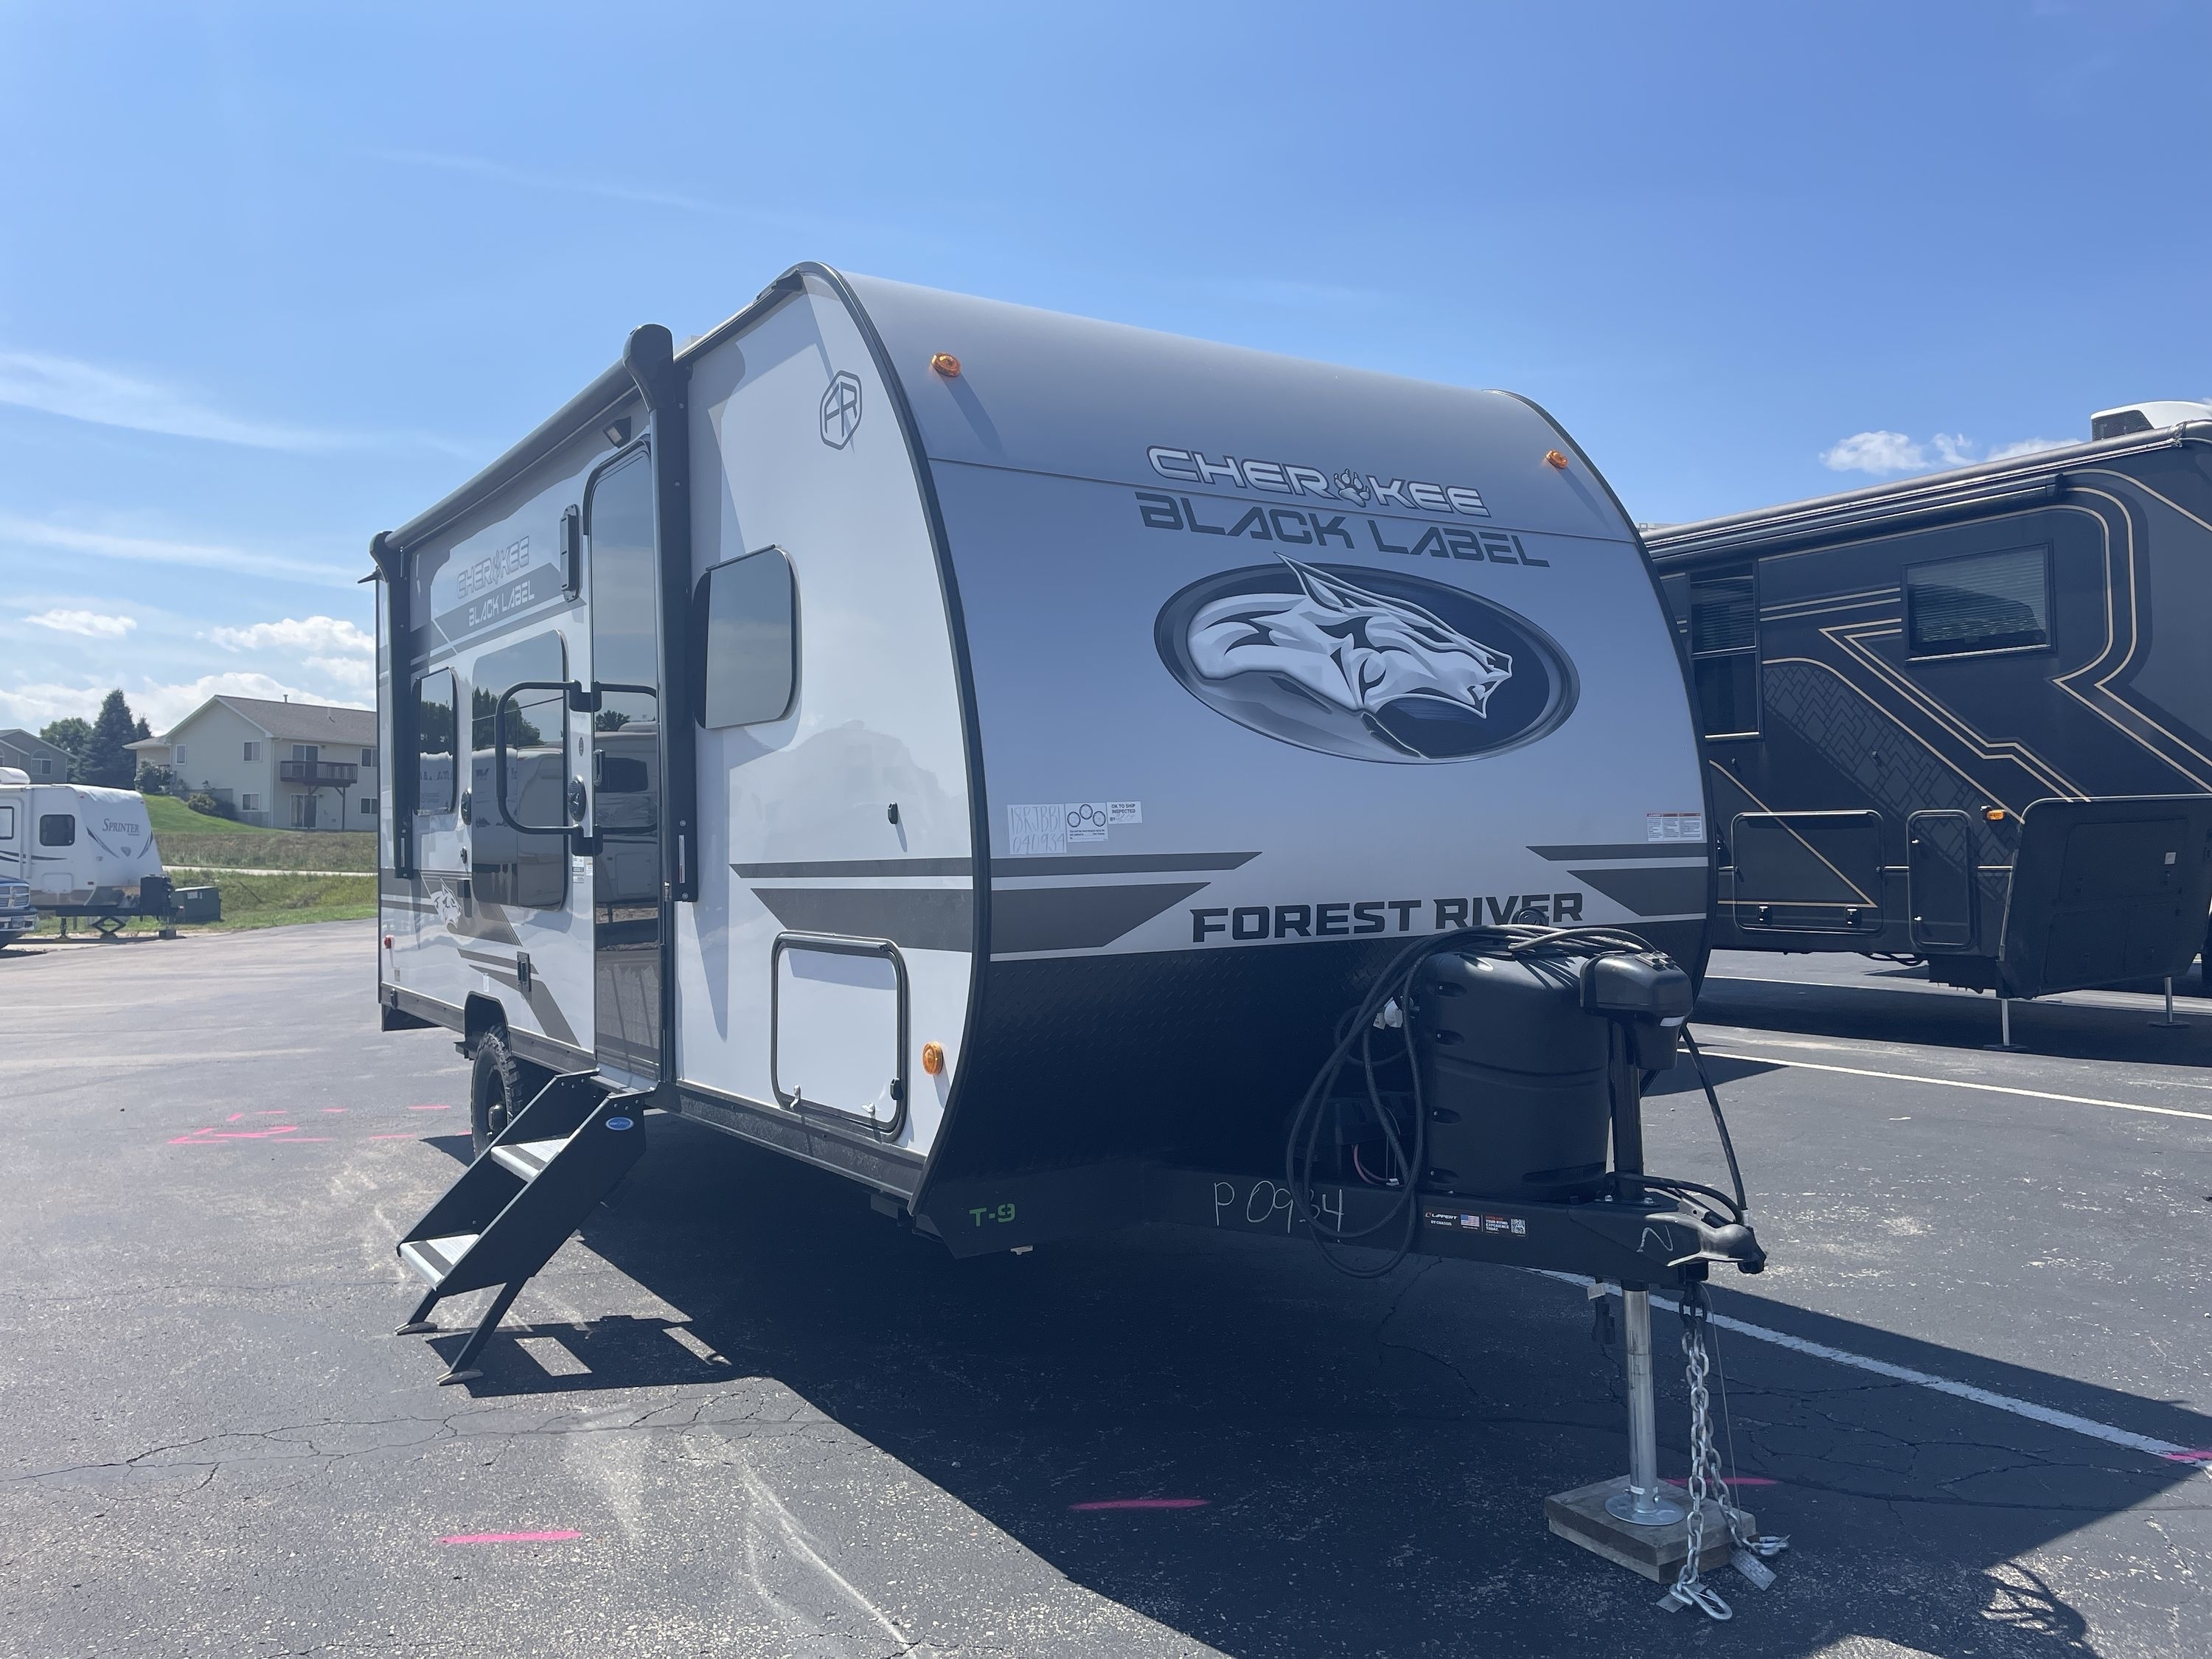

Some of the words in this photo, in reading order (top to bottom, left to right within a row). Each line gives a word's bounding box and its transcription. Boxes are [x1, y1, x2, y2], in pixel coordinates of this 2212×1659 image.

[1134, 491, 1355, 549] BLACK
[1366, 519, 1551, 568] LABEL
[468, 594, 499, 627] BLACK
[501, 580, 535, 612] LABEL
[1189, 900, 1422, 942] FOREST
[1433, 892, 1583, 930] RIVER
[968, 1203, 1016, 1228] T-9
[1214, 1181, 1236, 1227] P
